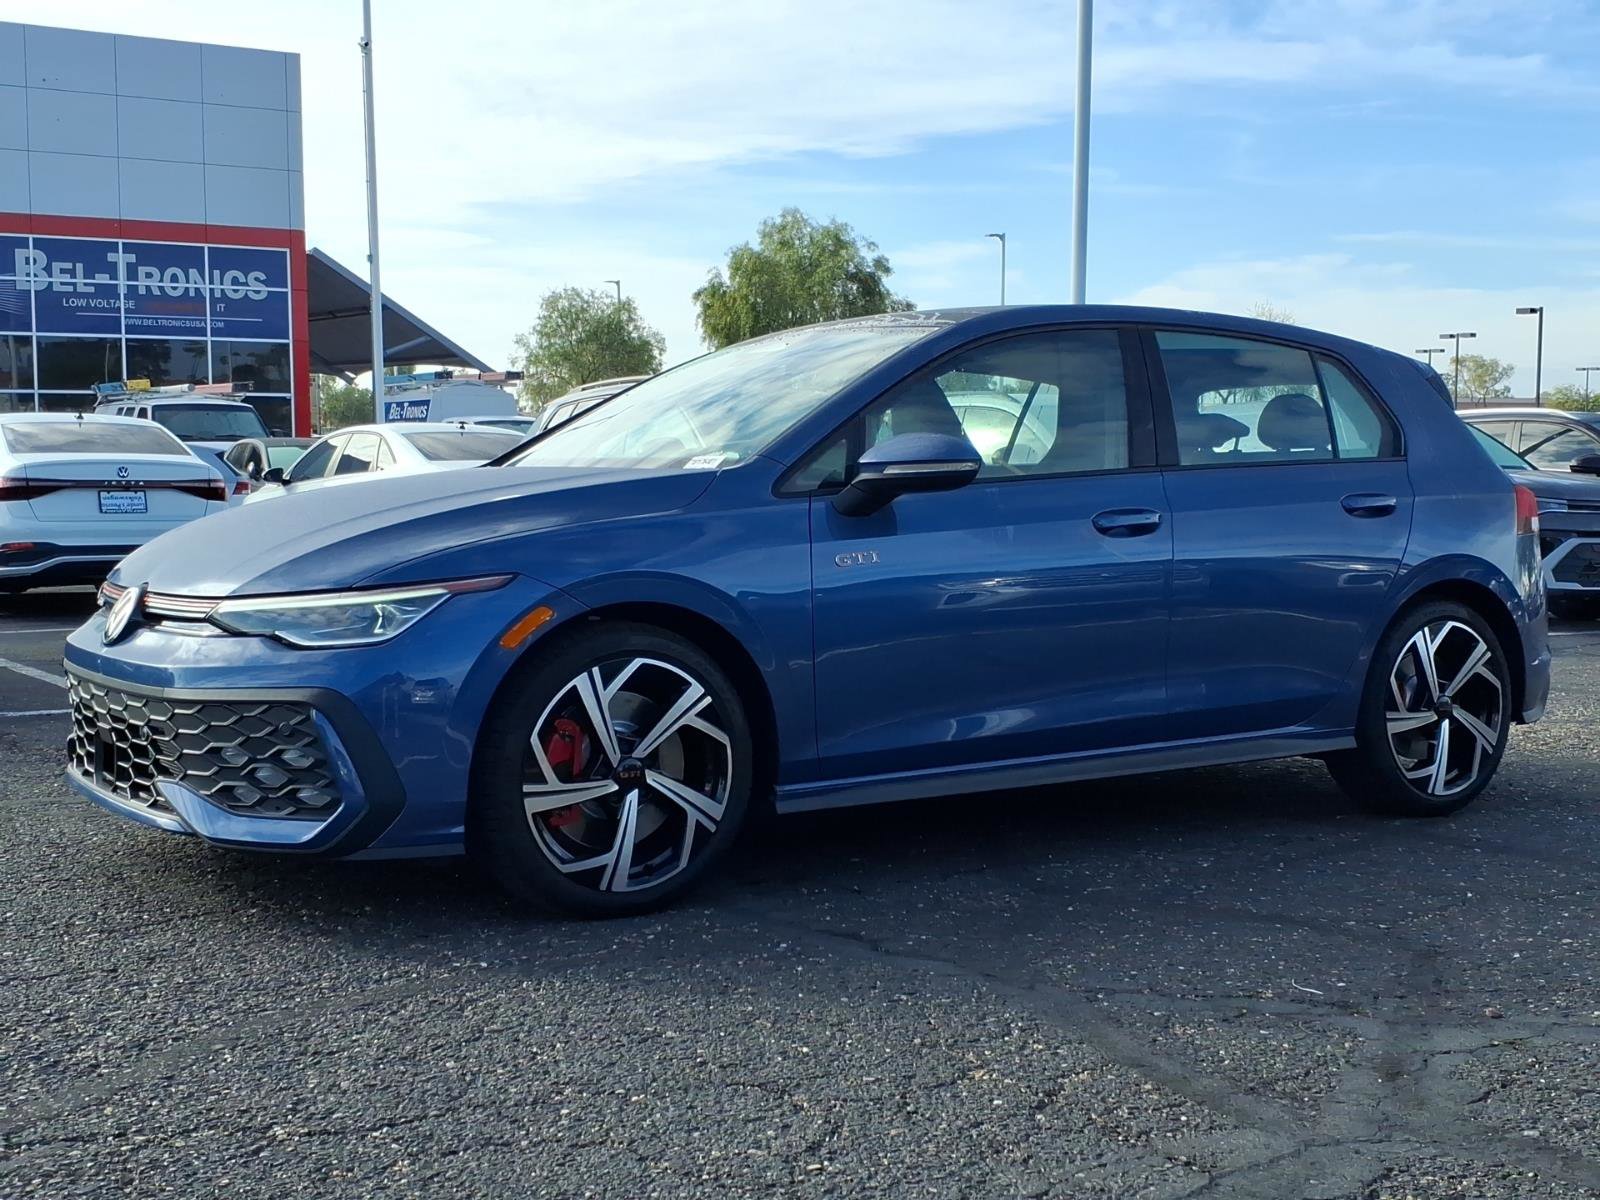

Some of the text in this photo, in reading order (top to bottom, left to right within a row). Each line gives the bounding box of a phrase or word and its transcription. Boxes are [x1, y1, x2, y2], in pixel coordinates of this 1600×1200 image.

[14, 248, 268, 301] BEL-TRONICS
[63, 298, 87, 308] LOW
[90, 299, 136, 309] VOLTAGE
[216, 303, 226, 312] IT
[124, 318, 225, 329] WWW.BELTRONICSUSACOM
[834, 551, 881, 567] GTI
[619, 770, 641, 779] GTI
